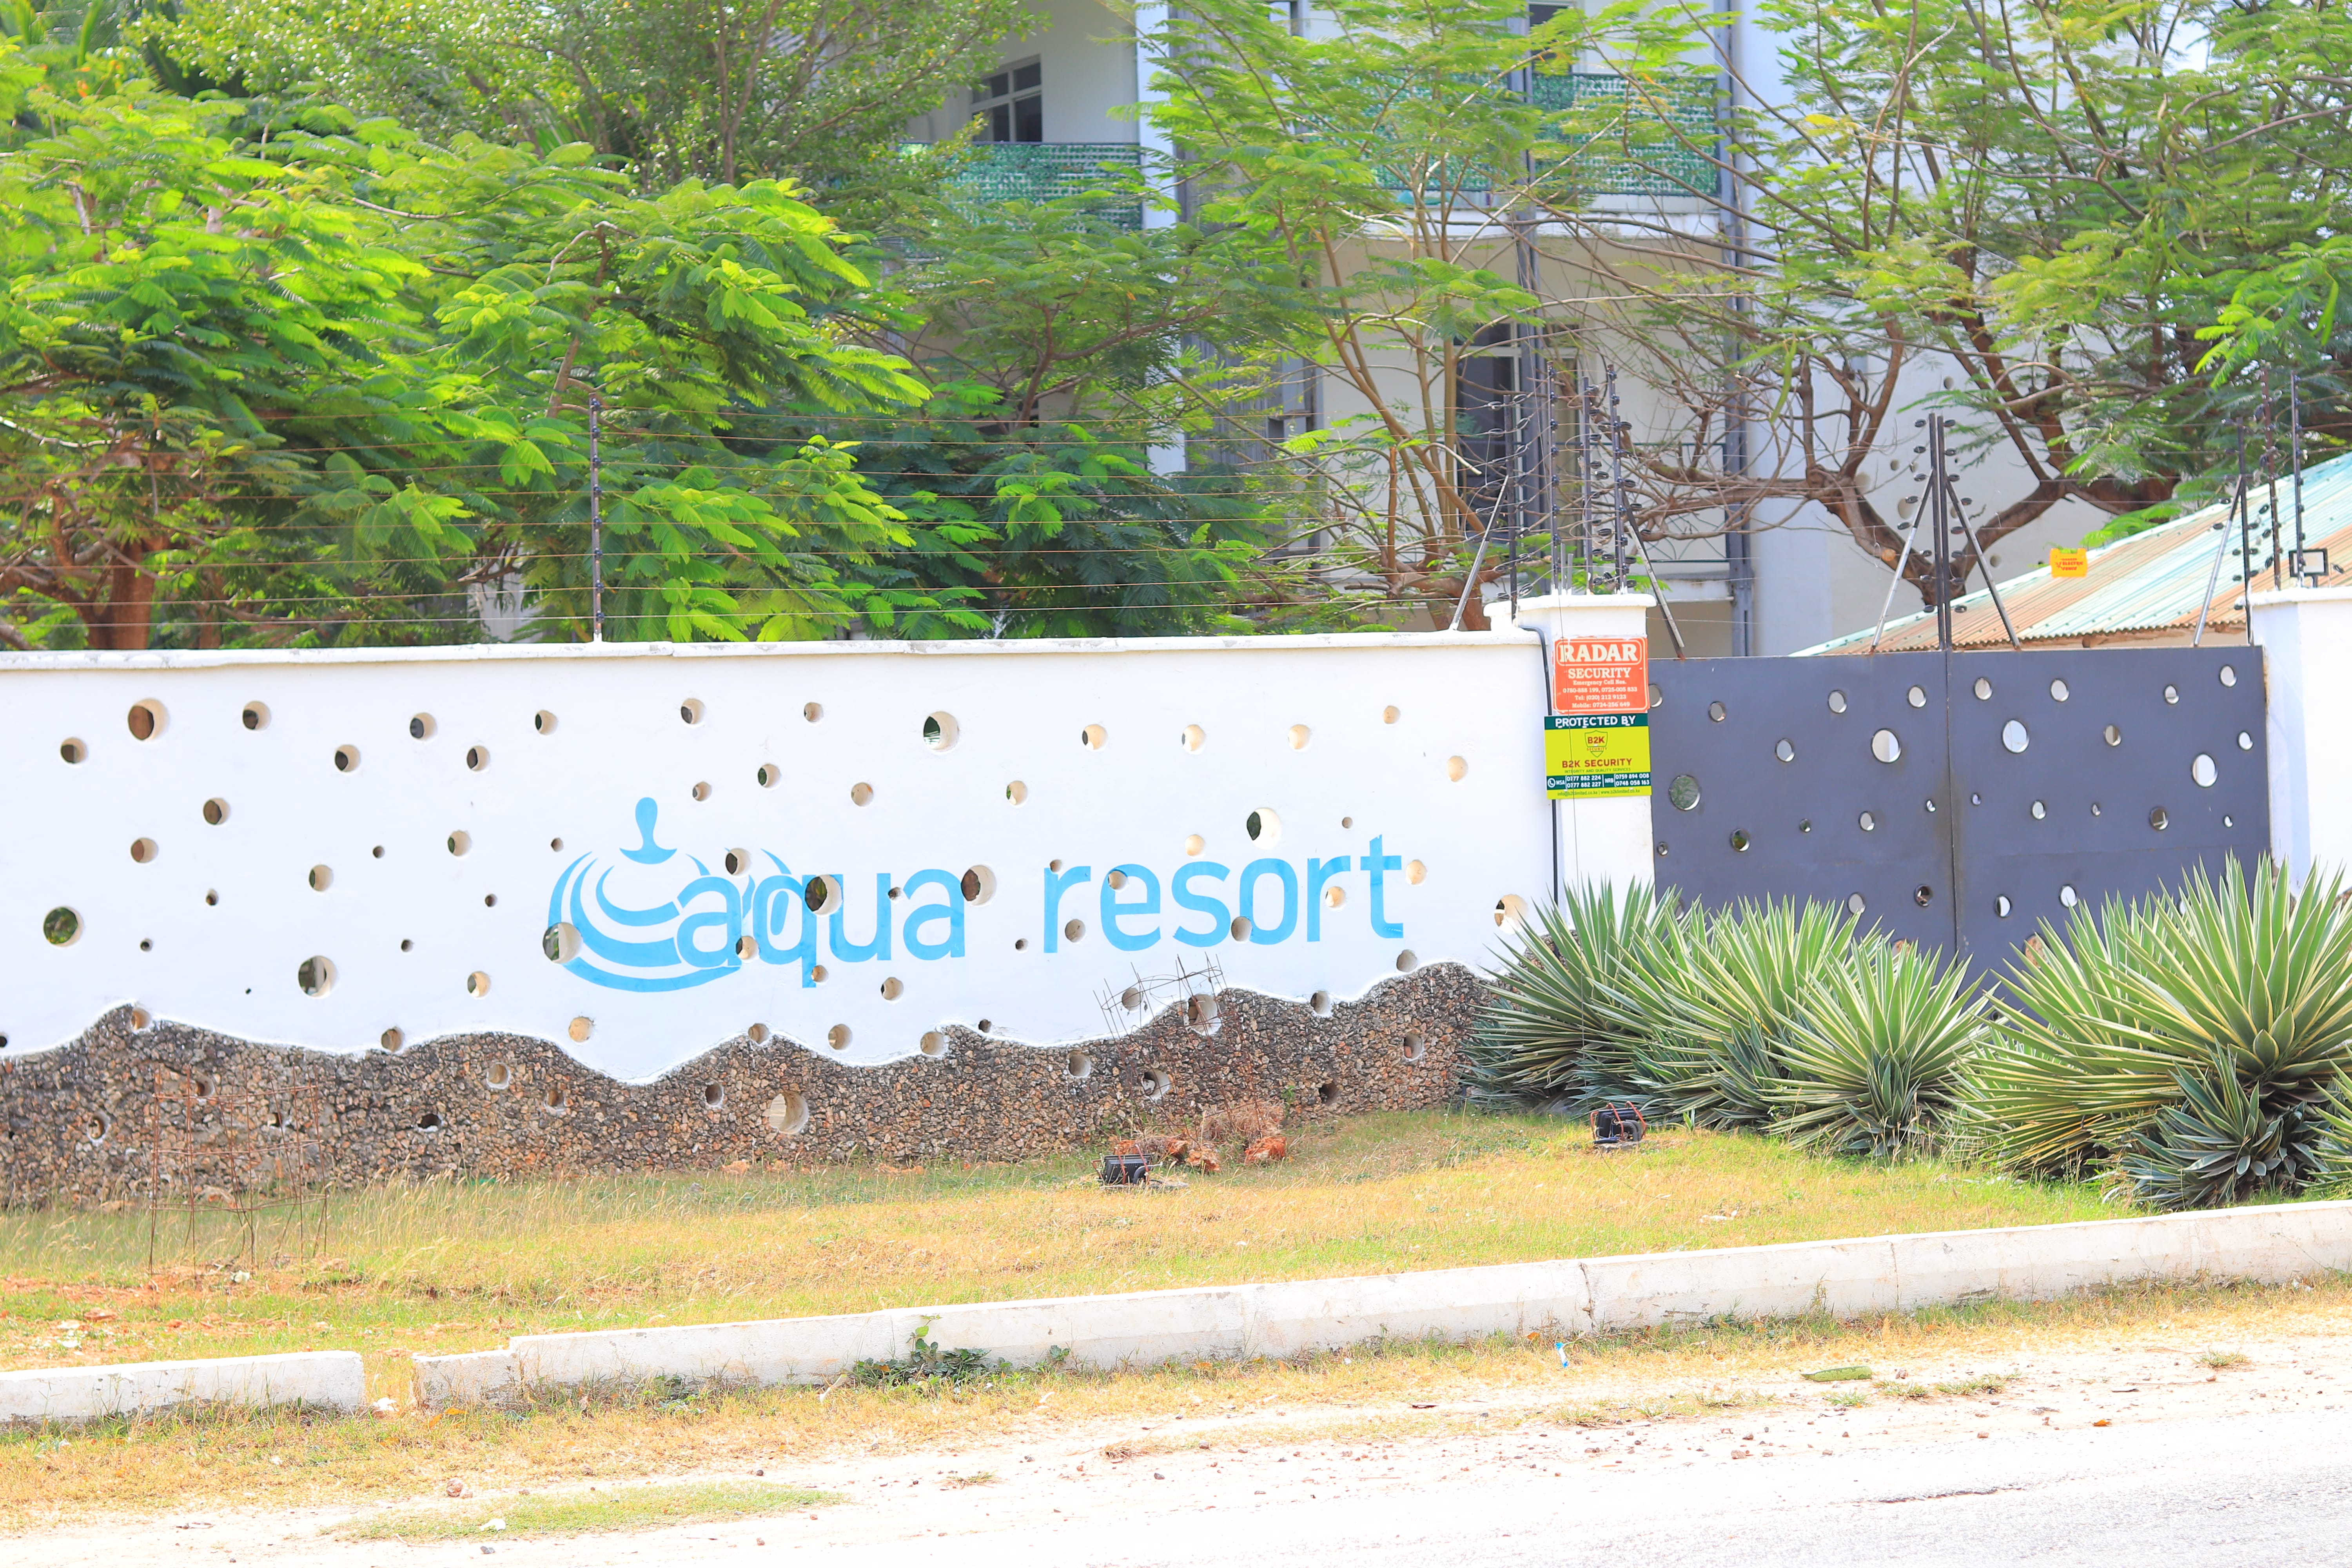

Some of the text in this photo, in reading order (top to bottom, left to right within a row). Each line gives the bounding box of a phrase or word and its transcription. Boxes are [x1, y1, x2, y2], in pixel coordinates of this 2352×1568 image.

[1559, 644, 1638, 662] RADAR
[1568, 667, 1631, 679] SECURITY
[1555, 715, 1636, 727] PROTECTED BY
[1584, 758, 1632, 767] SECURITY
[677, 834, 1404, 988] aqua resort
